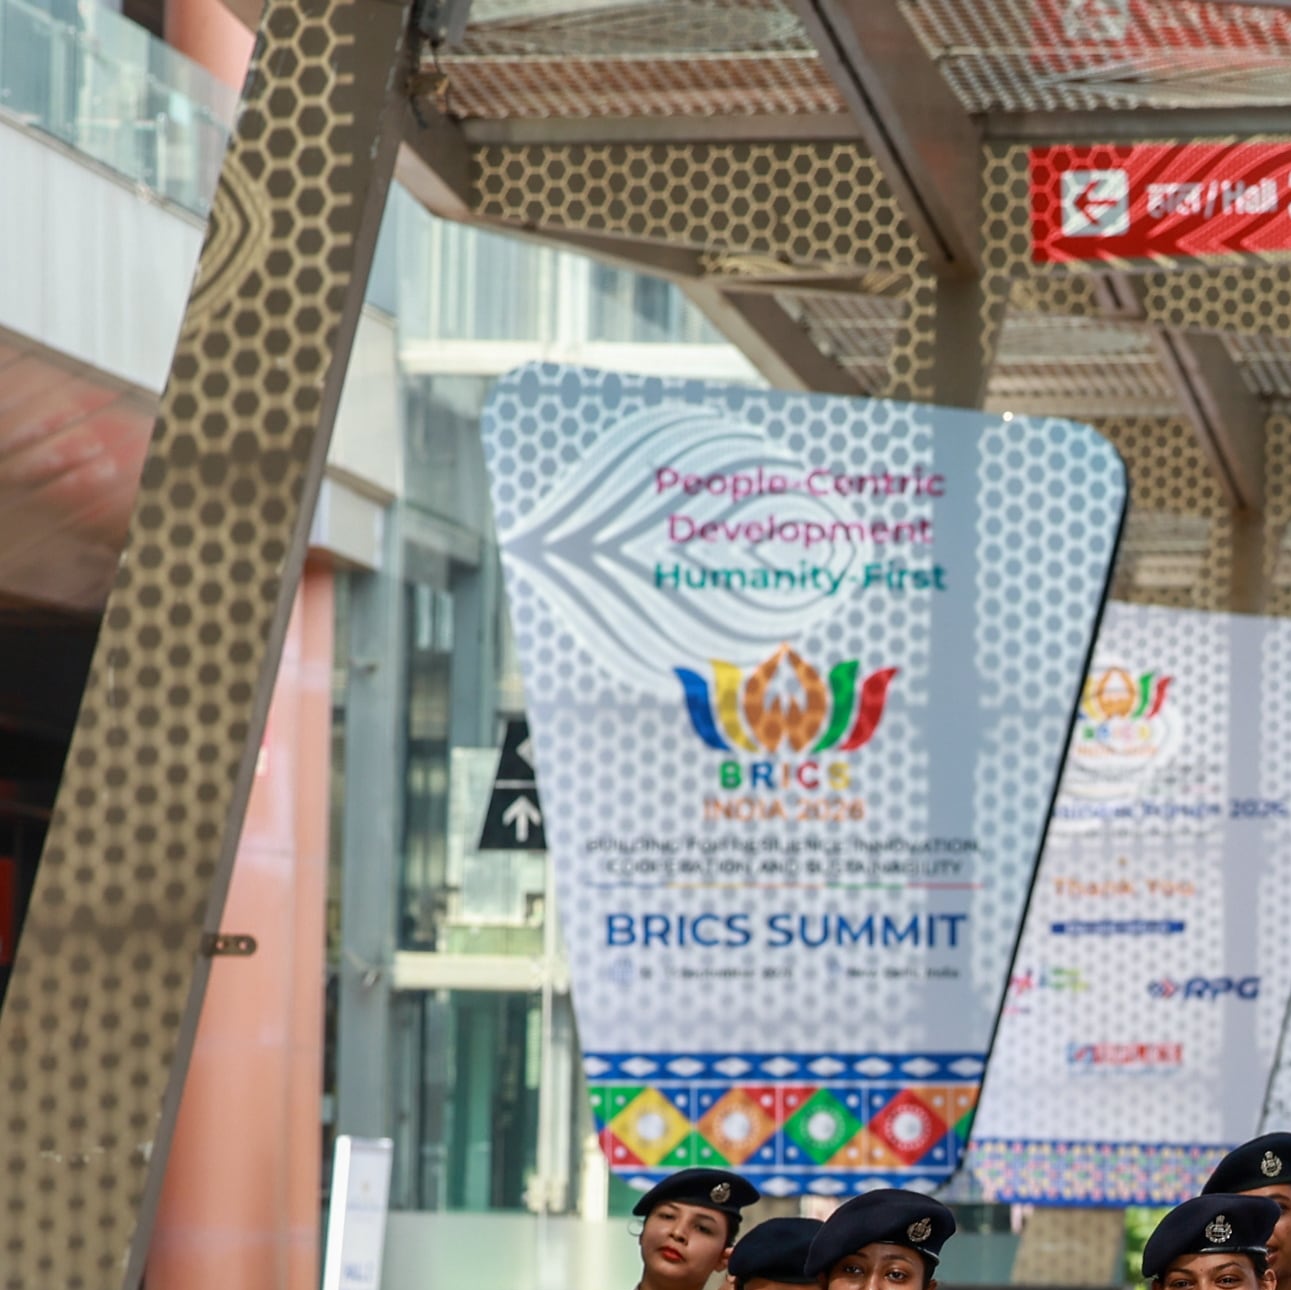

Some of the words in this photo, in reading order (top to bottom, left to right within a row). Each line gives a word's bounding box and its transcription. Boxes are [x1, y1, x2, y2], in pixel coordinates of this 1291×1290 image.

[653, 467, 947, 502] People-Centric
[667, 514, 933, 550] Development
[718, 761, 851, 790] BRICS
[605, 913, 751, 948] BRICS
[767, 913, 969, 949] SUMMIT
[1185, 977, 1260, 1000] RPG
